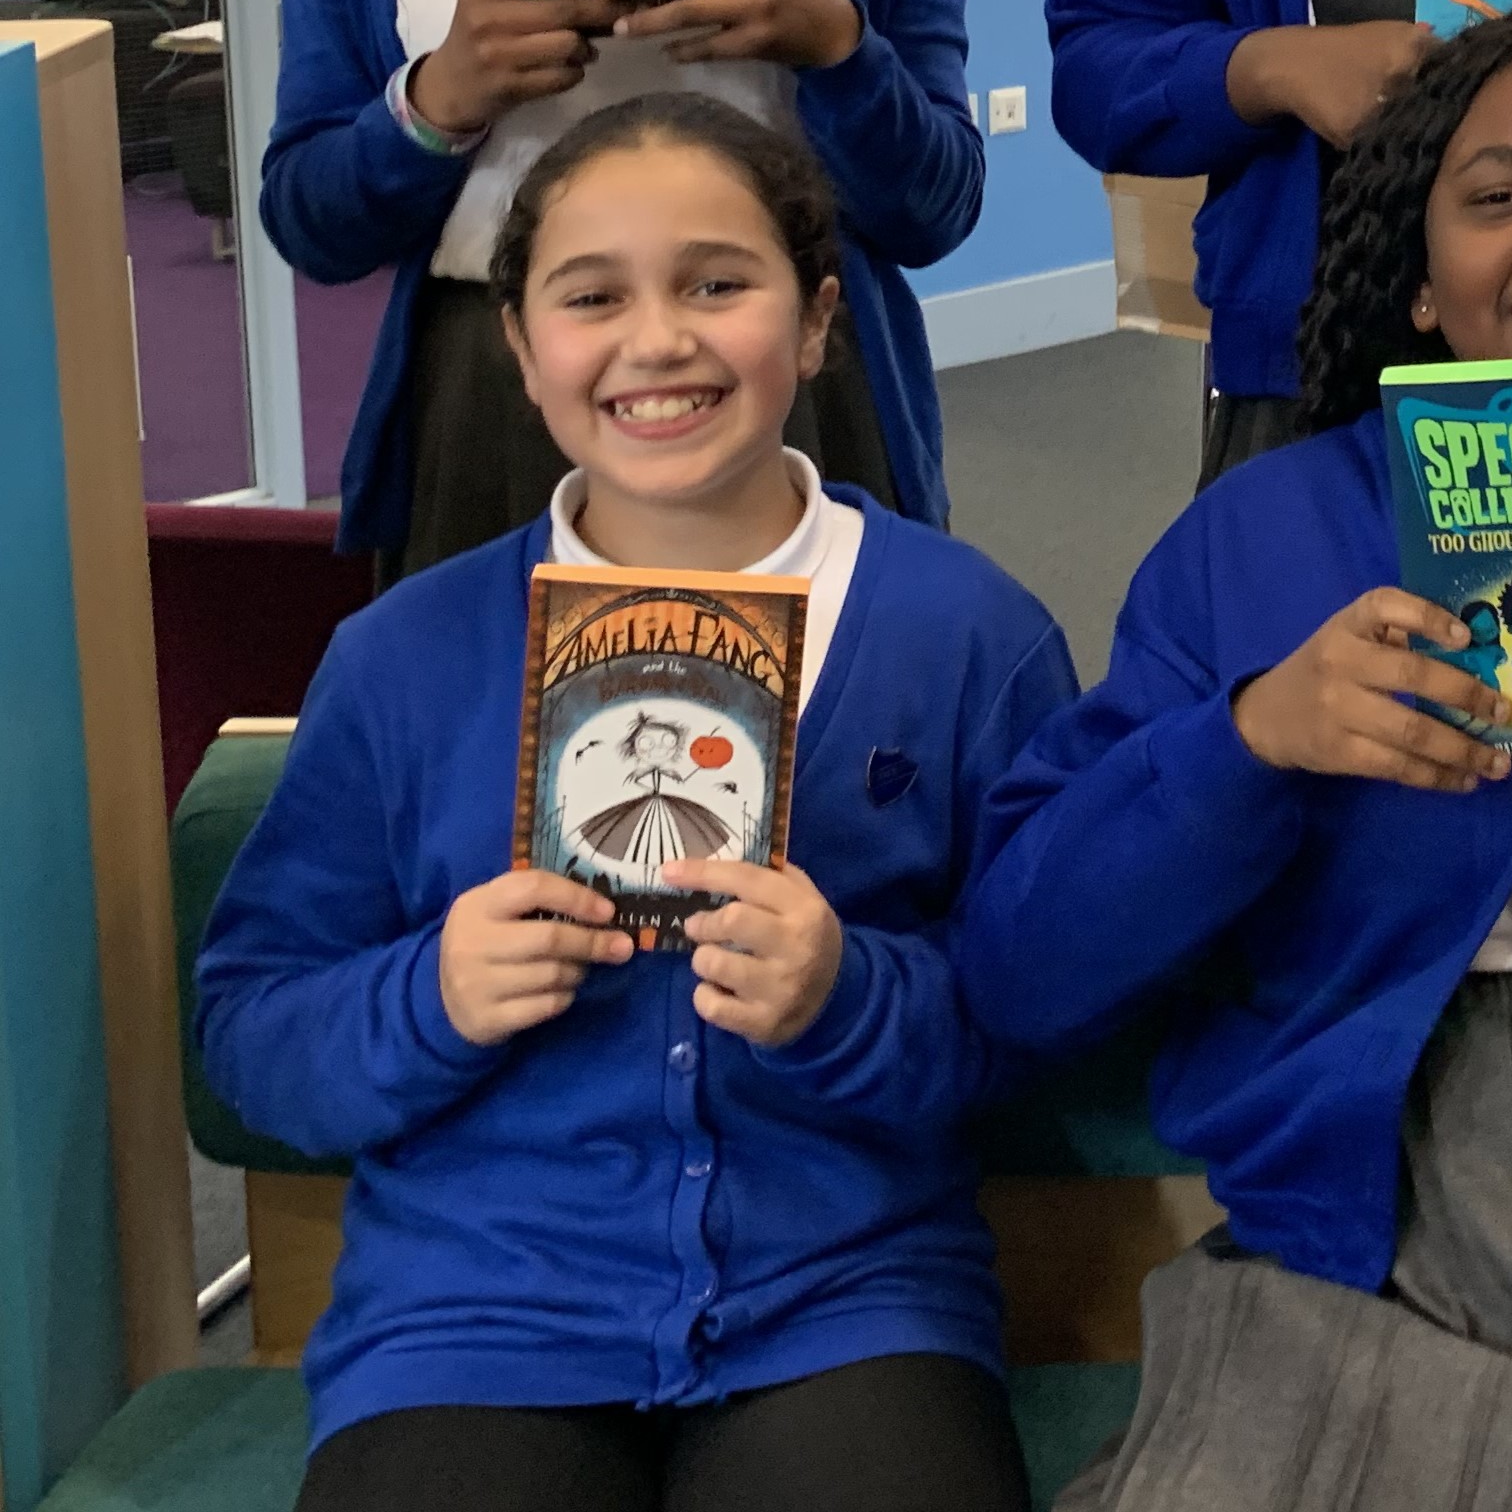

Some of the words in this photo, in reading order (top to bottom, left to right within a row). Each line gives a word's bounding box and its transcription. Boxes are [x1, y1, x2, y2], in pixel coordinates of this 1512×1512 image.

[1428, 533, 1465, 555] TOO
[689, 606, 771, 688] FANG
[641, 661, 665, 674] and
[668, 661, 687, 675] the
